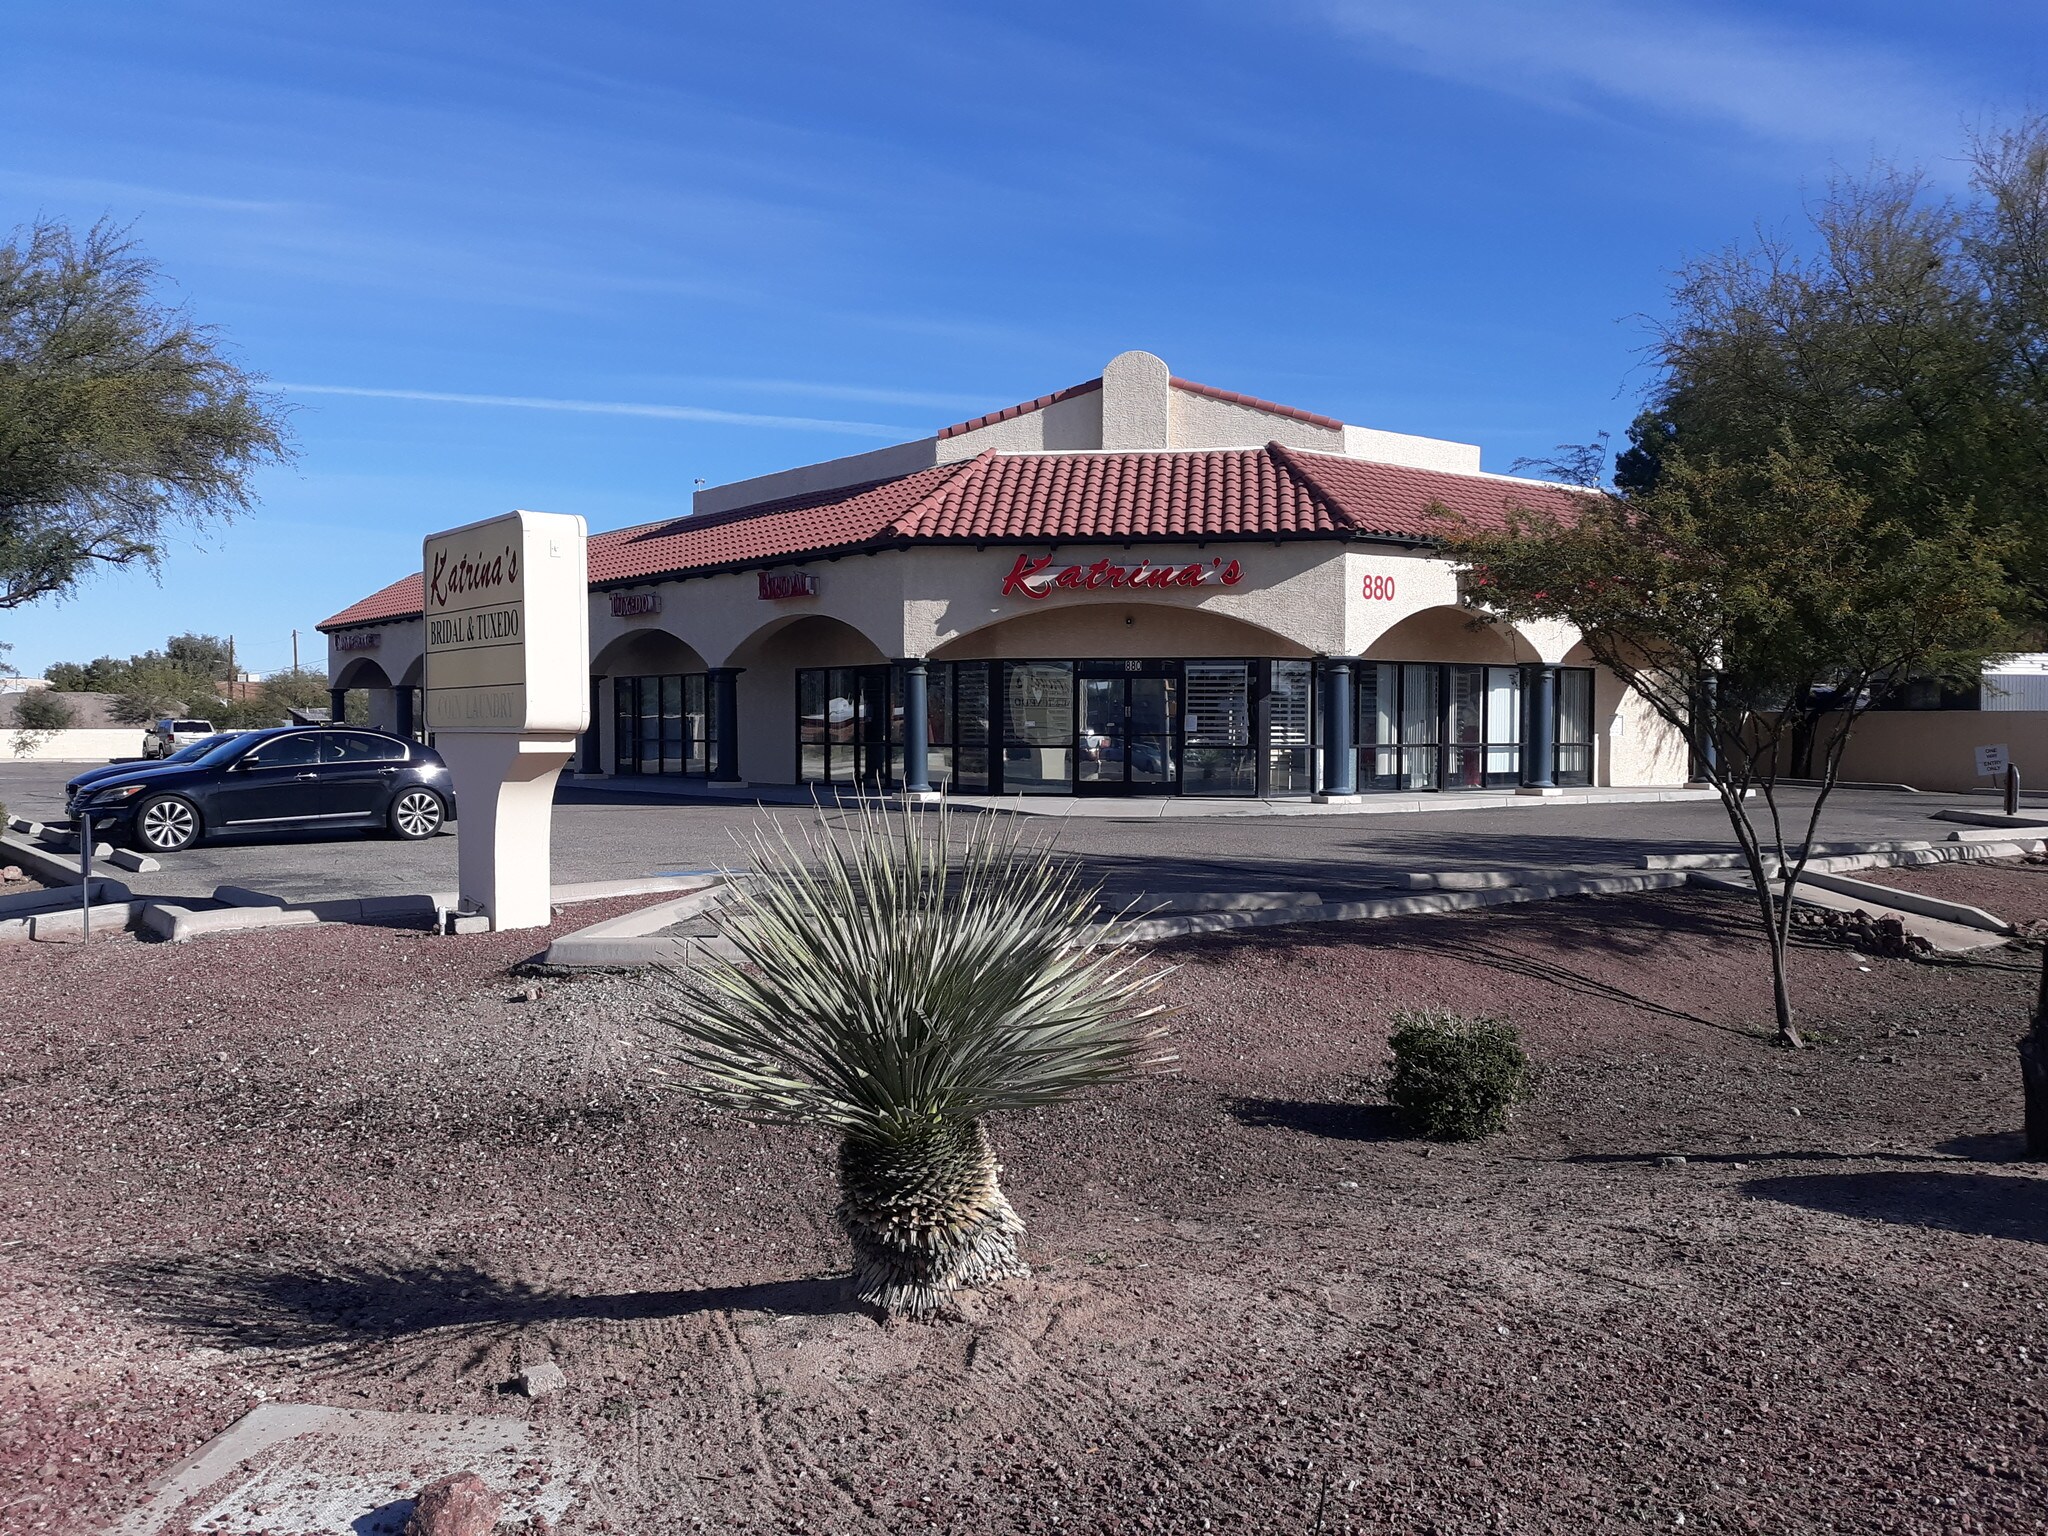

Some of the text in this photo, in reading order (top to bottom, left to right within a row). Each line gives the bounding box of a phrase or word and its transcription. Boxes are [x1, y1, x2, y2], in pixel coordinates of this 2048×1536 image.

[431, 545, 519, 607] Katrina's
[1001, 553, 1246, 600] Katrina's
[1362, 574, 1396, 602] 880
[430, 609, 519, 645] BRIDAL & TUXEDO
[1125, 660, 1142, 672] 880
